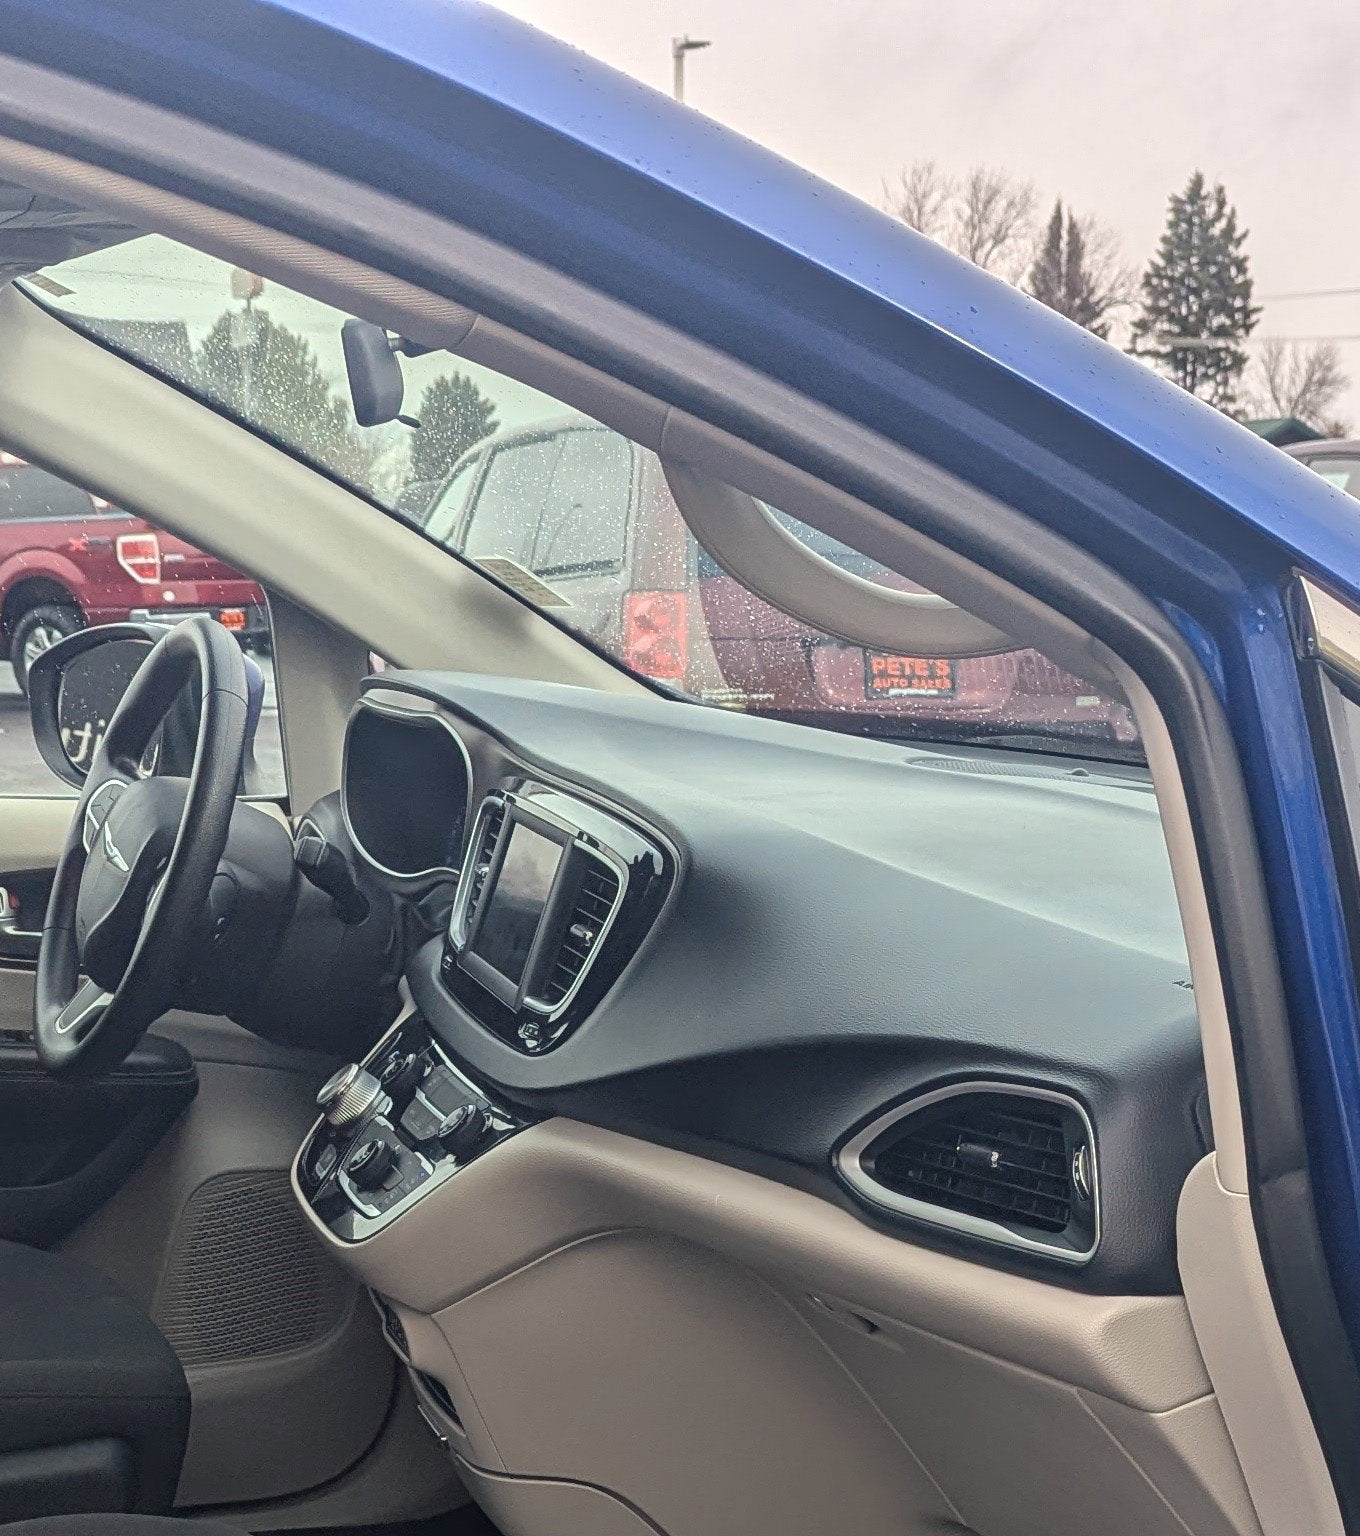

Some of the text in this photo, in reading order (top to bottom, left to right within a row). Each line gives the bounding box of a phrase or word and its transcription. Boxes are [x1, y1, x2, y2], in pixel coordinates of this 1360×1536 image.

[871, 656, 951, 676] PETE'S
[872, 677, 953, 689] AUTO SALES
